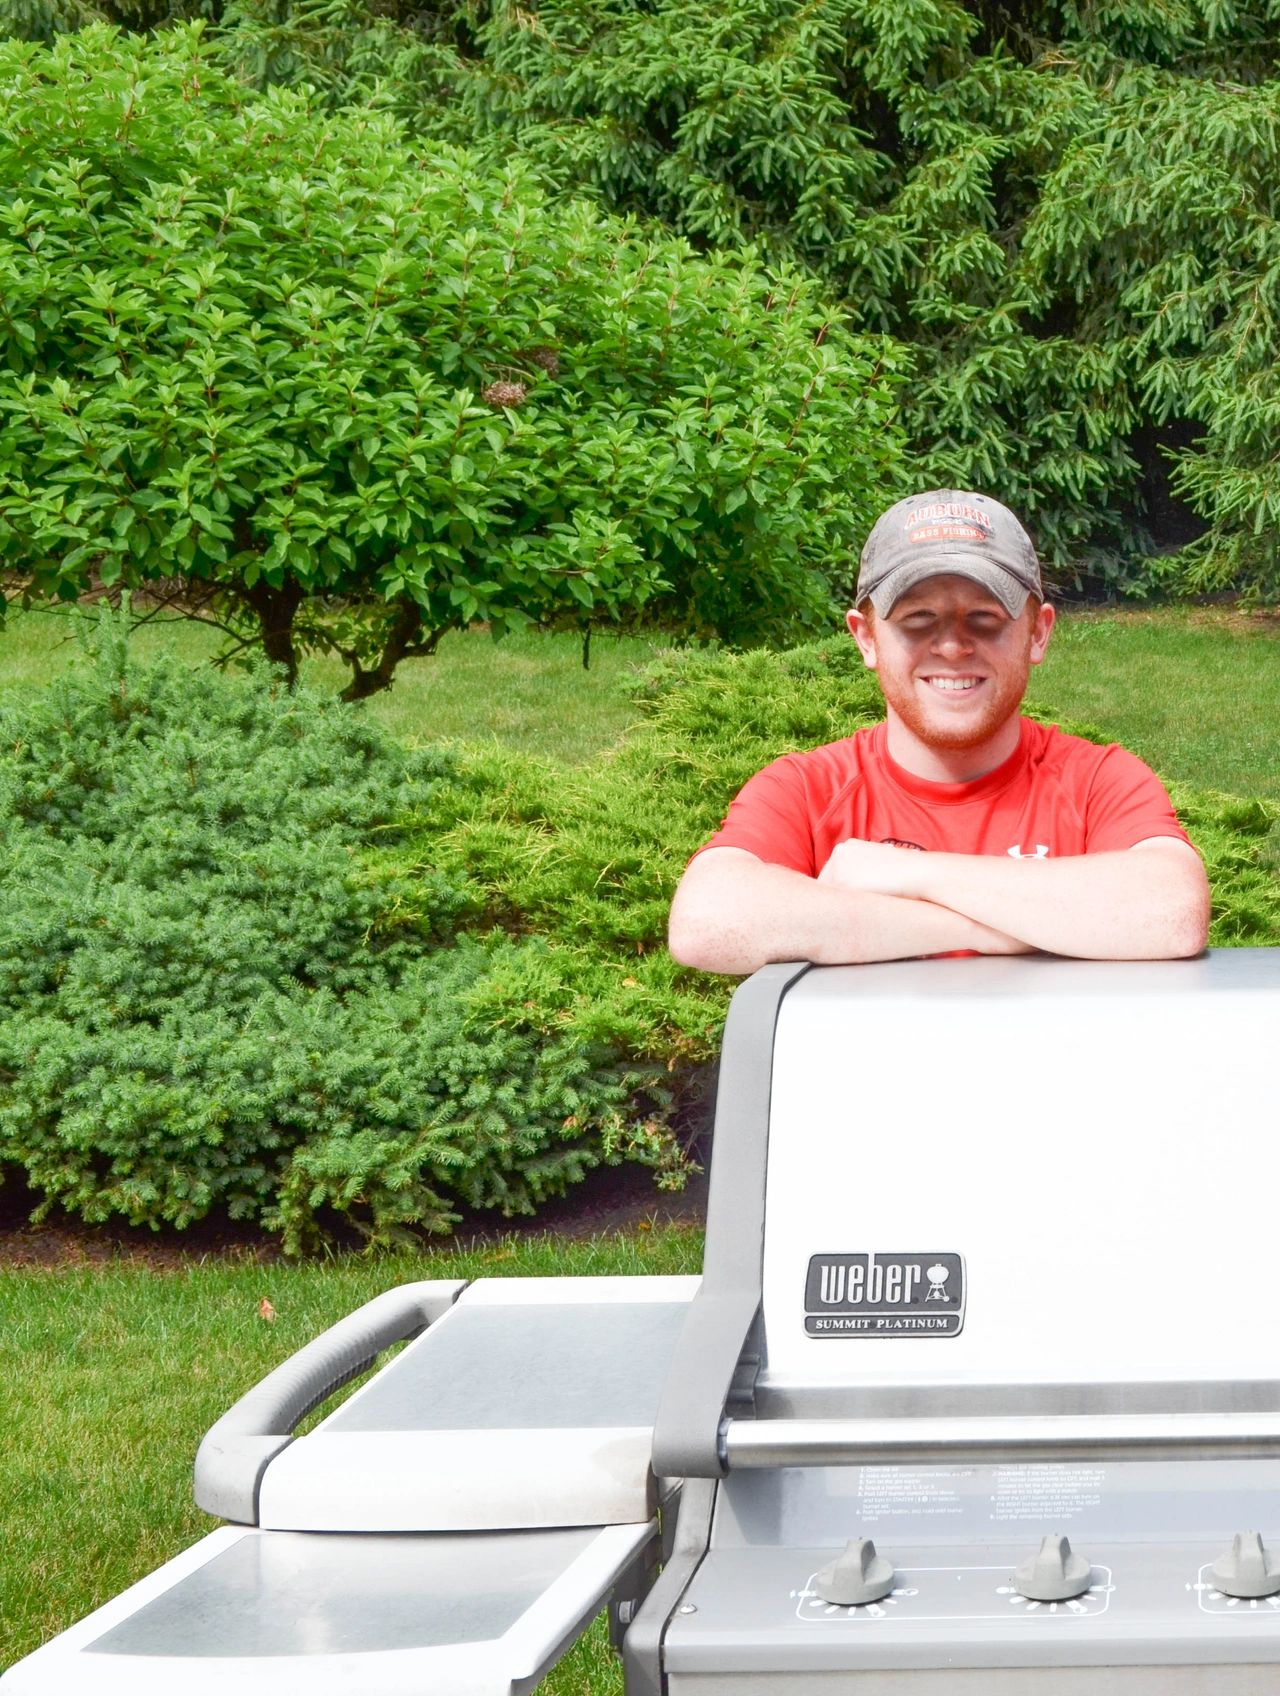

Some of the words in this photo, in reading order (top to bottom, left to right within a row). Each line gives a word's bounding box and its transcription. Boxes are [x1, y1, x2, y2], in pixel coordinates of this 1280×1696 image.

[904, 503, 993, 530] AUBURN
[820, 1254, 921, 1304] weber
[816, 1319, 871, 1329] SUMMIT
[876, 1318, 949, 1329] PLATINUM
